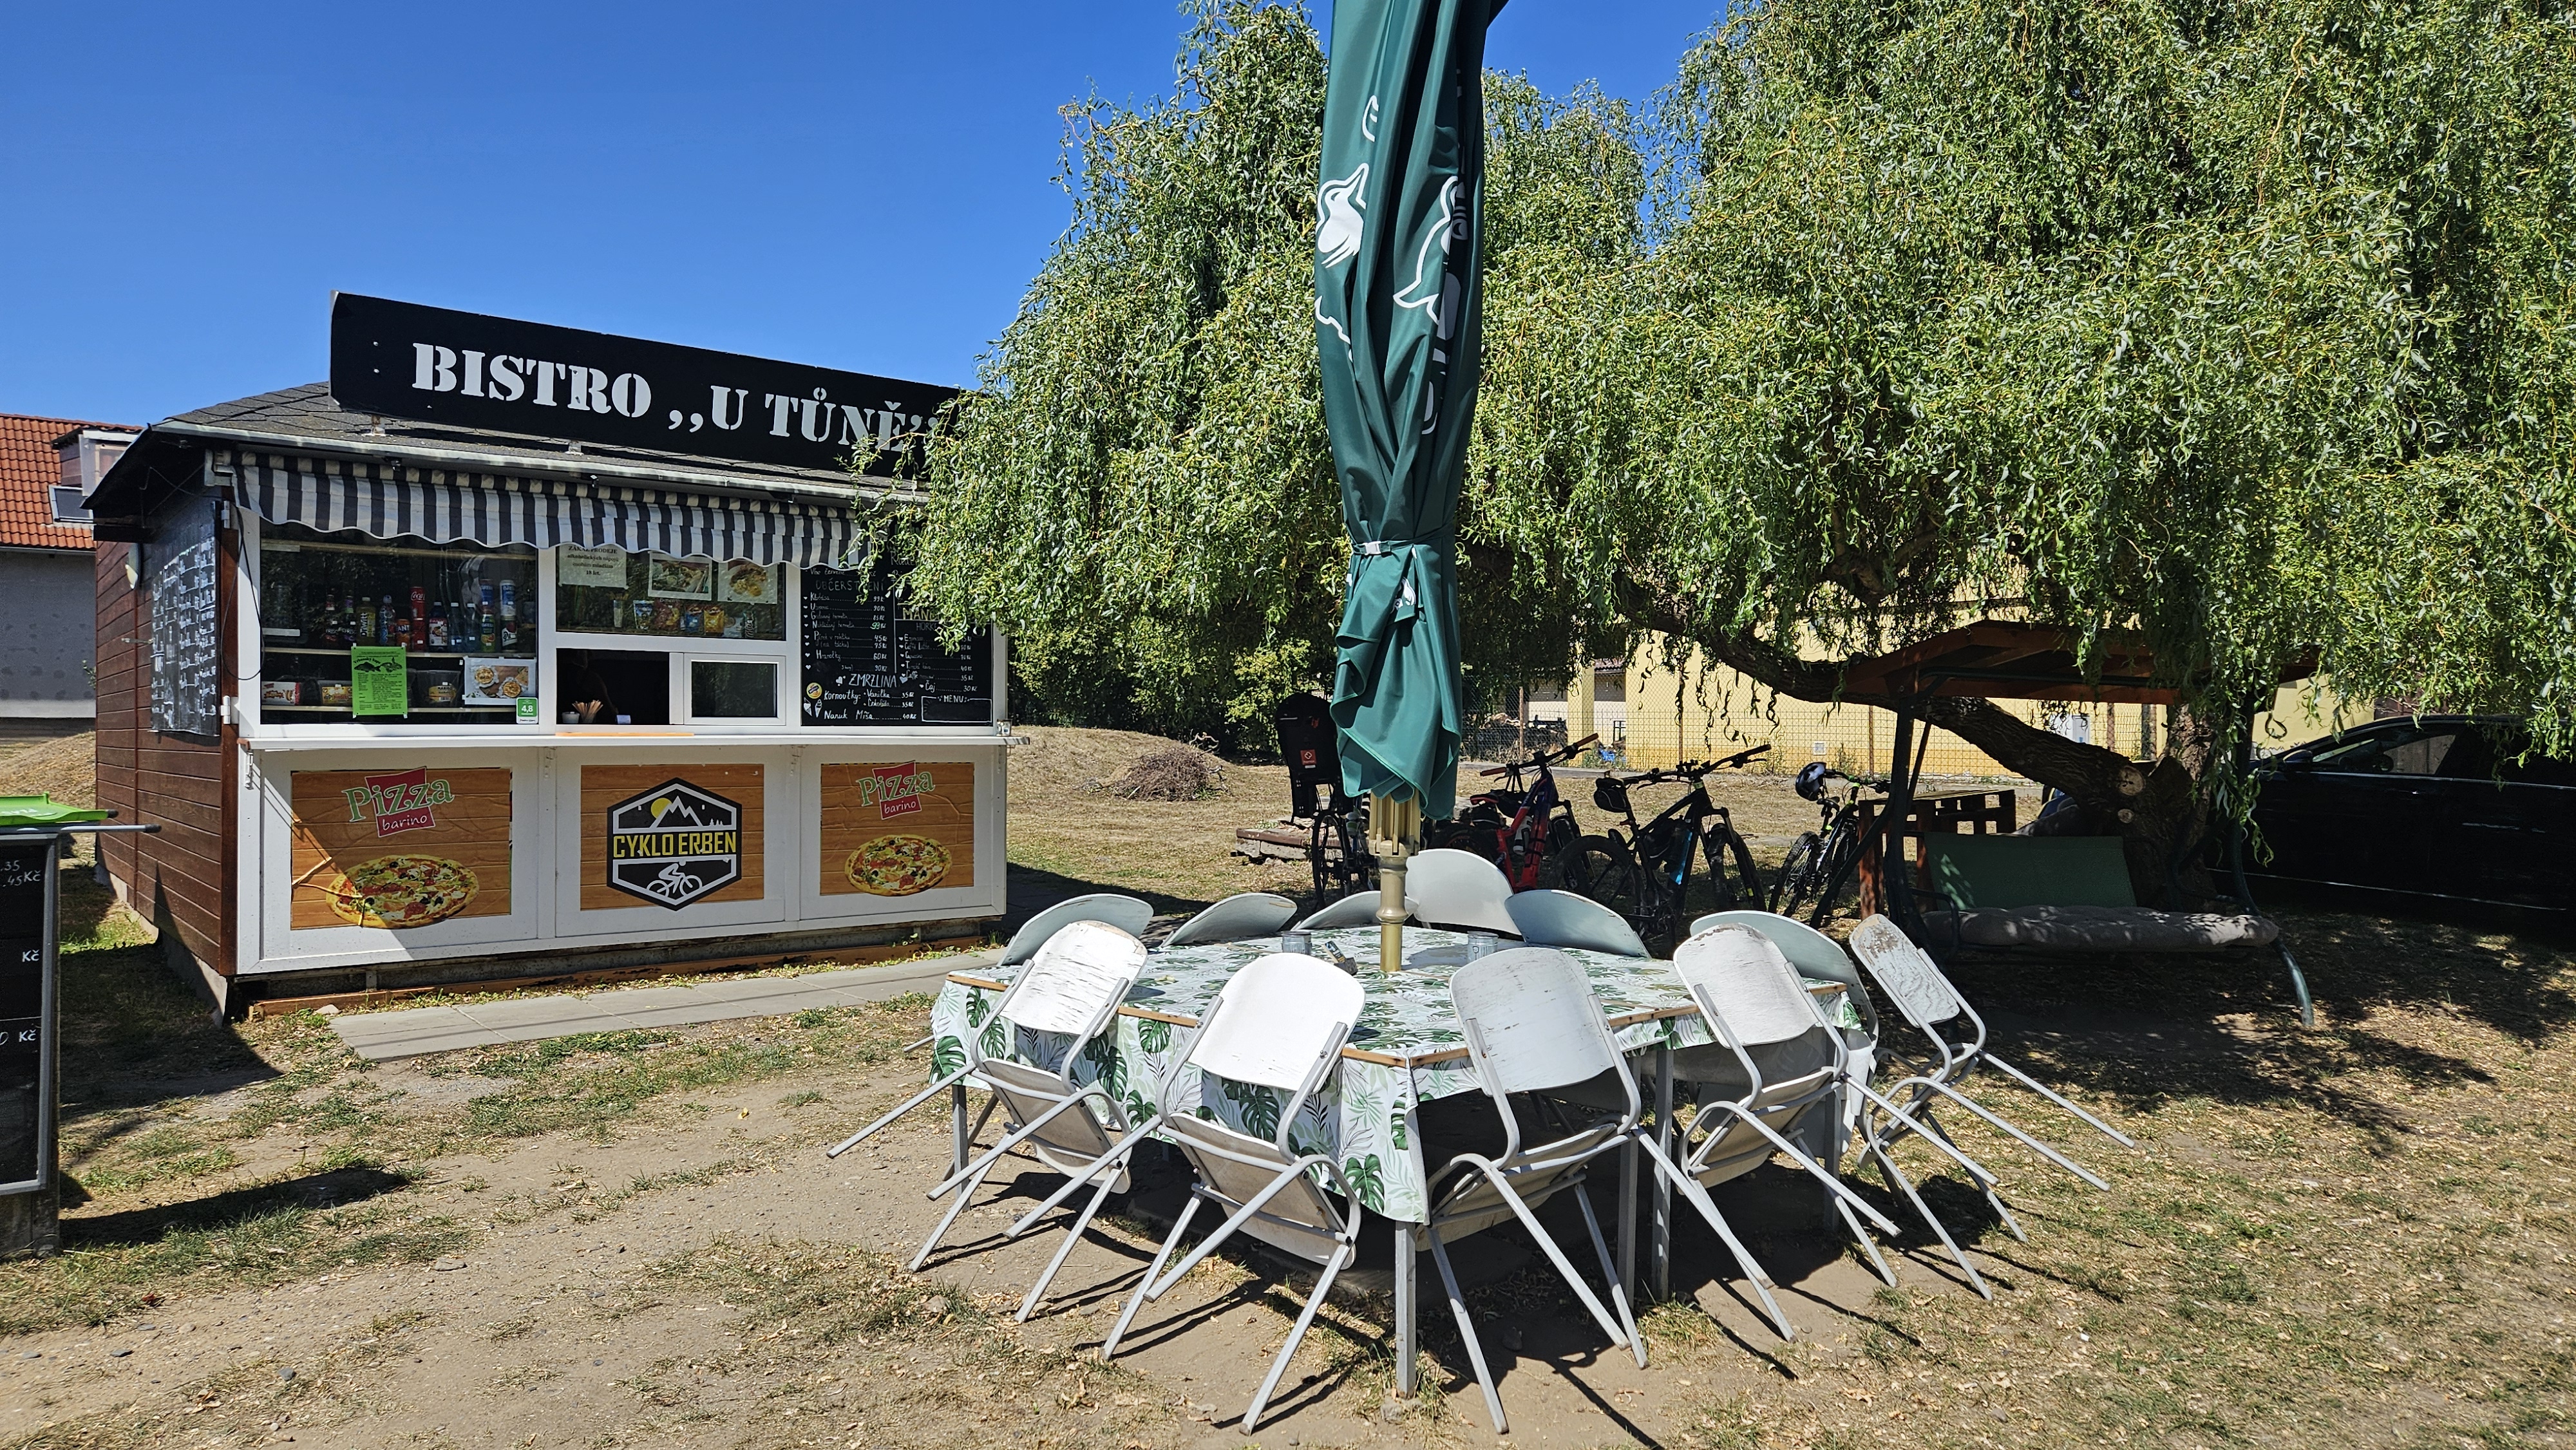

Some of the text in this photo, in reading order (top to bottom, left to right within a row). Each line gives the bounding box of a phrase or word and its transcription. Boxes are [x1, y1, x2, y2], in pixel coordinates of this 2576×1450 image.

[412, 342, 652, 418] BISTRO
[848, 673, 897, 688] ZMRZLINA
[521, 704, 533, 713] 4,8
[856, 771, 936, 807] Pizza
[341, 779, 455, 823] Pizza
[884, 800, 916, 814] barino
[382, 814, 428, 831] barino
[613, 831, 737, 858] CYKLO ERBEN
[22, 949, 39, 963] Kč
[19, 1029, 37, 1042] Kč
